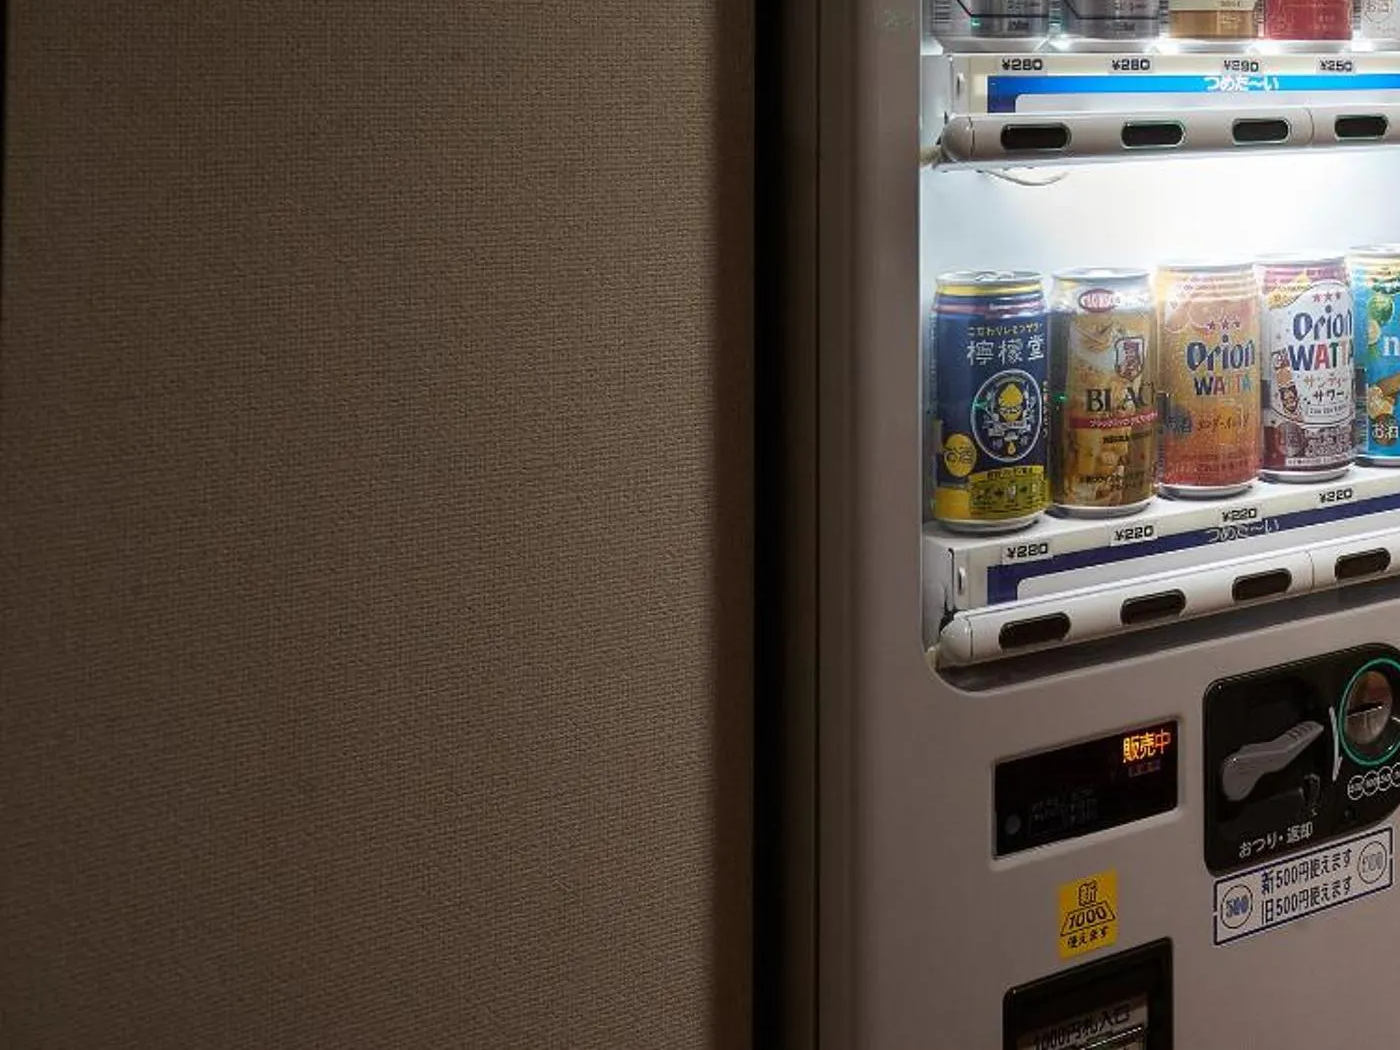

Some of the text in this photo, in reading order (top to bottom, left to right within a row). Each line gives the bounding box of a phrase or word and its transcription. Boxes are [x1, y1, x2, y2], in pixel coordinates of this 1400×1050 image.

[1002, 58, 1043, 71] ¥280
[1112, 58, 1150, 71] ¥280
[1222, 507, 1257, 522] ¥220
[1114, 525, 1154, 541] ¥220
[1122, 728, 1172, 764] 販売中
[1260, 848, 1353, 896] 新500円使えます
[1260, 876, 1353, 925] 旧500円使えます
[1068, 906, 1108, 930] 1000
